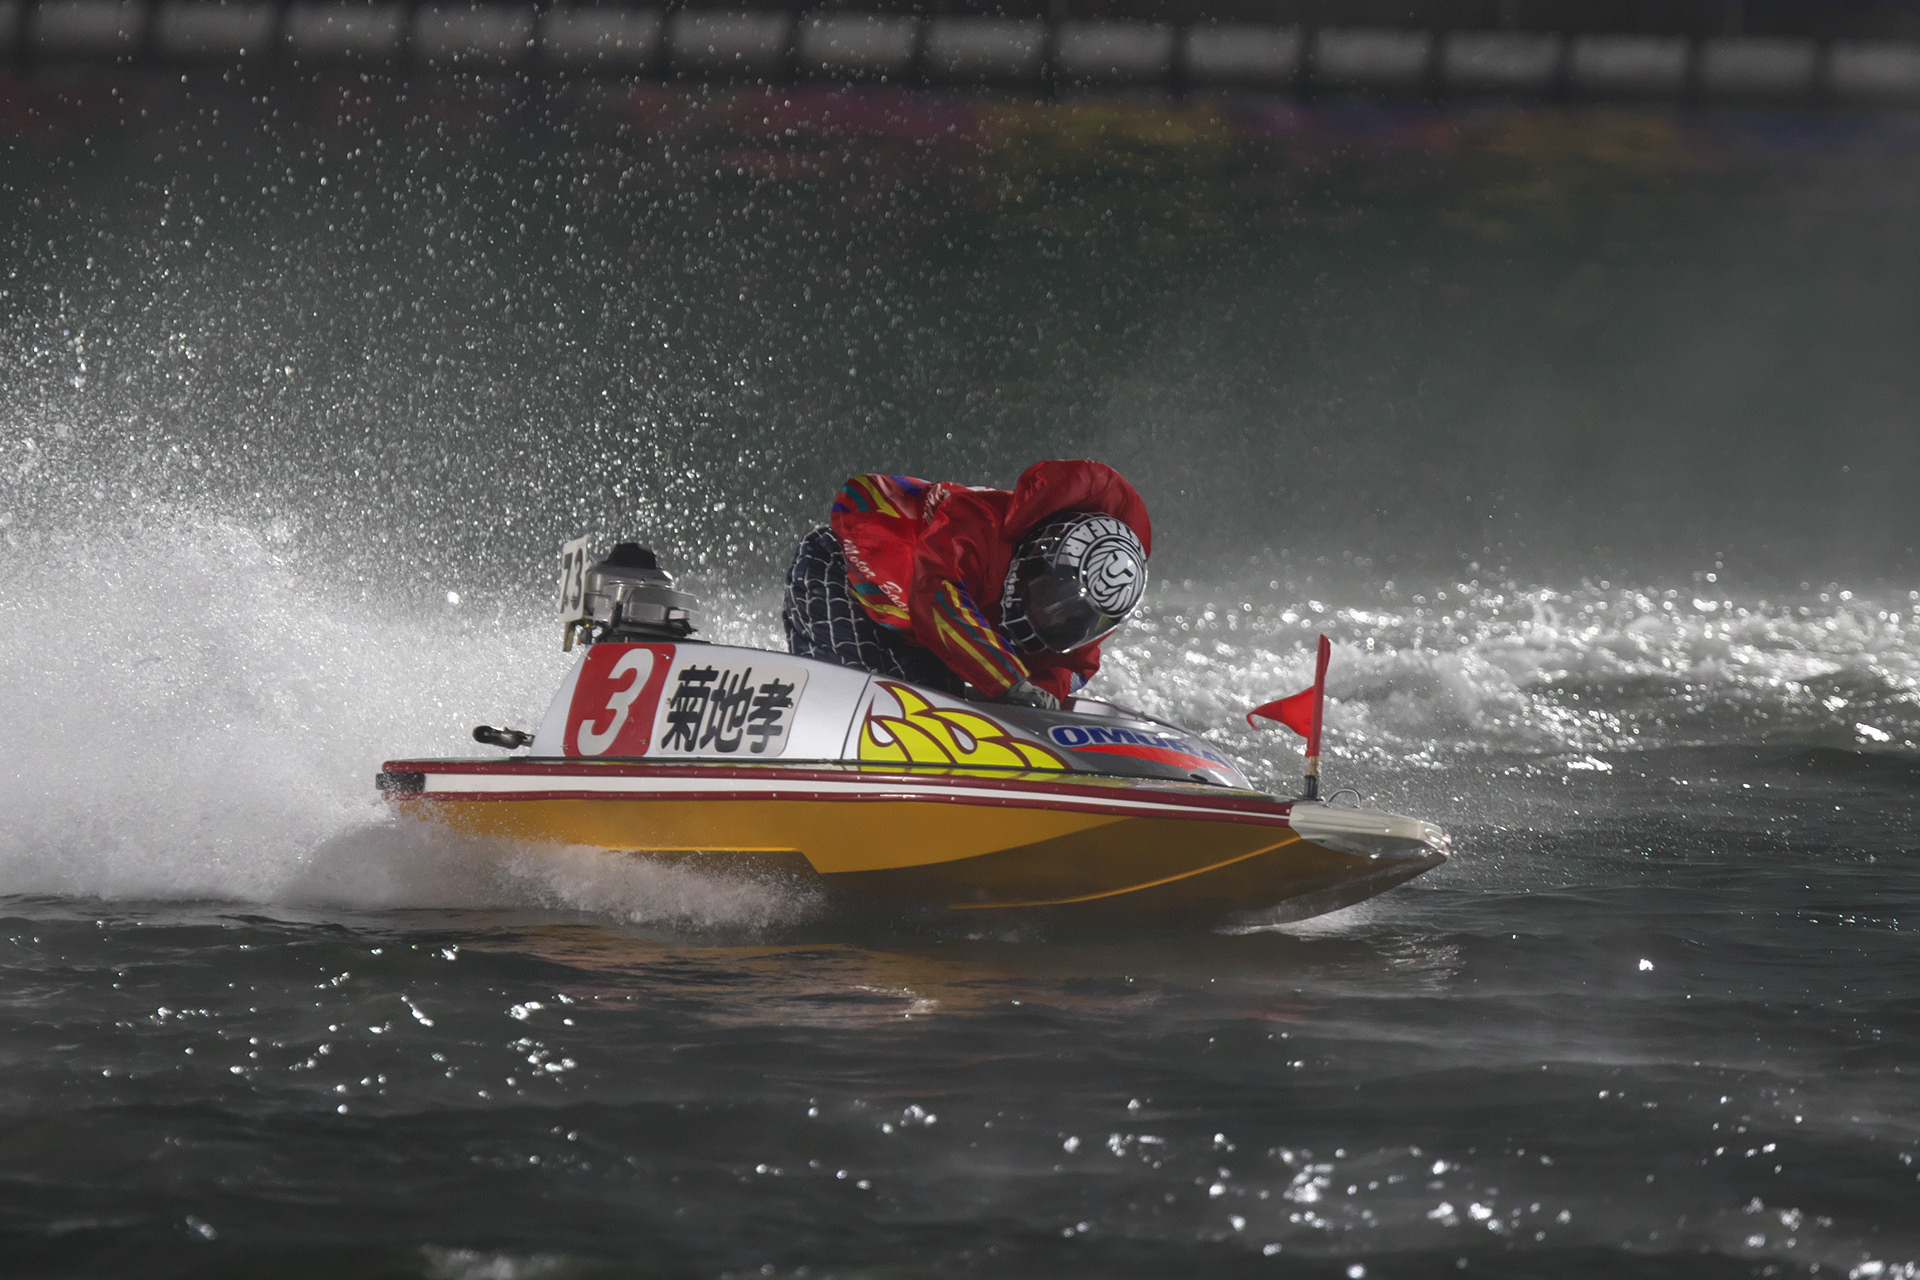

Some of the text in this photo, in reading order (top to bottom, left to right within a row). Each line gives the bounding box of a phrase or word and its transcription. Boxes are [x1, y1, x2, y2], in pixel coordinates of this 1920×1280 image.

[560, 547, 583, 614] 73
[577, 647, 655, 756] 3
[660, 664, 796, 754] 菊地孝
[1050, 725, 1229, 768] OMURA
